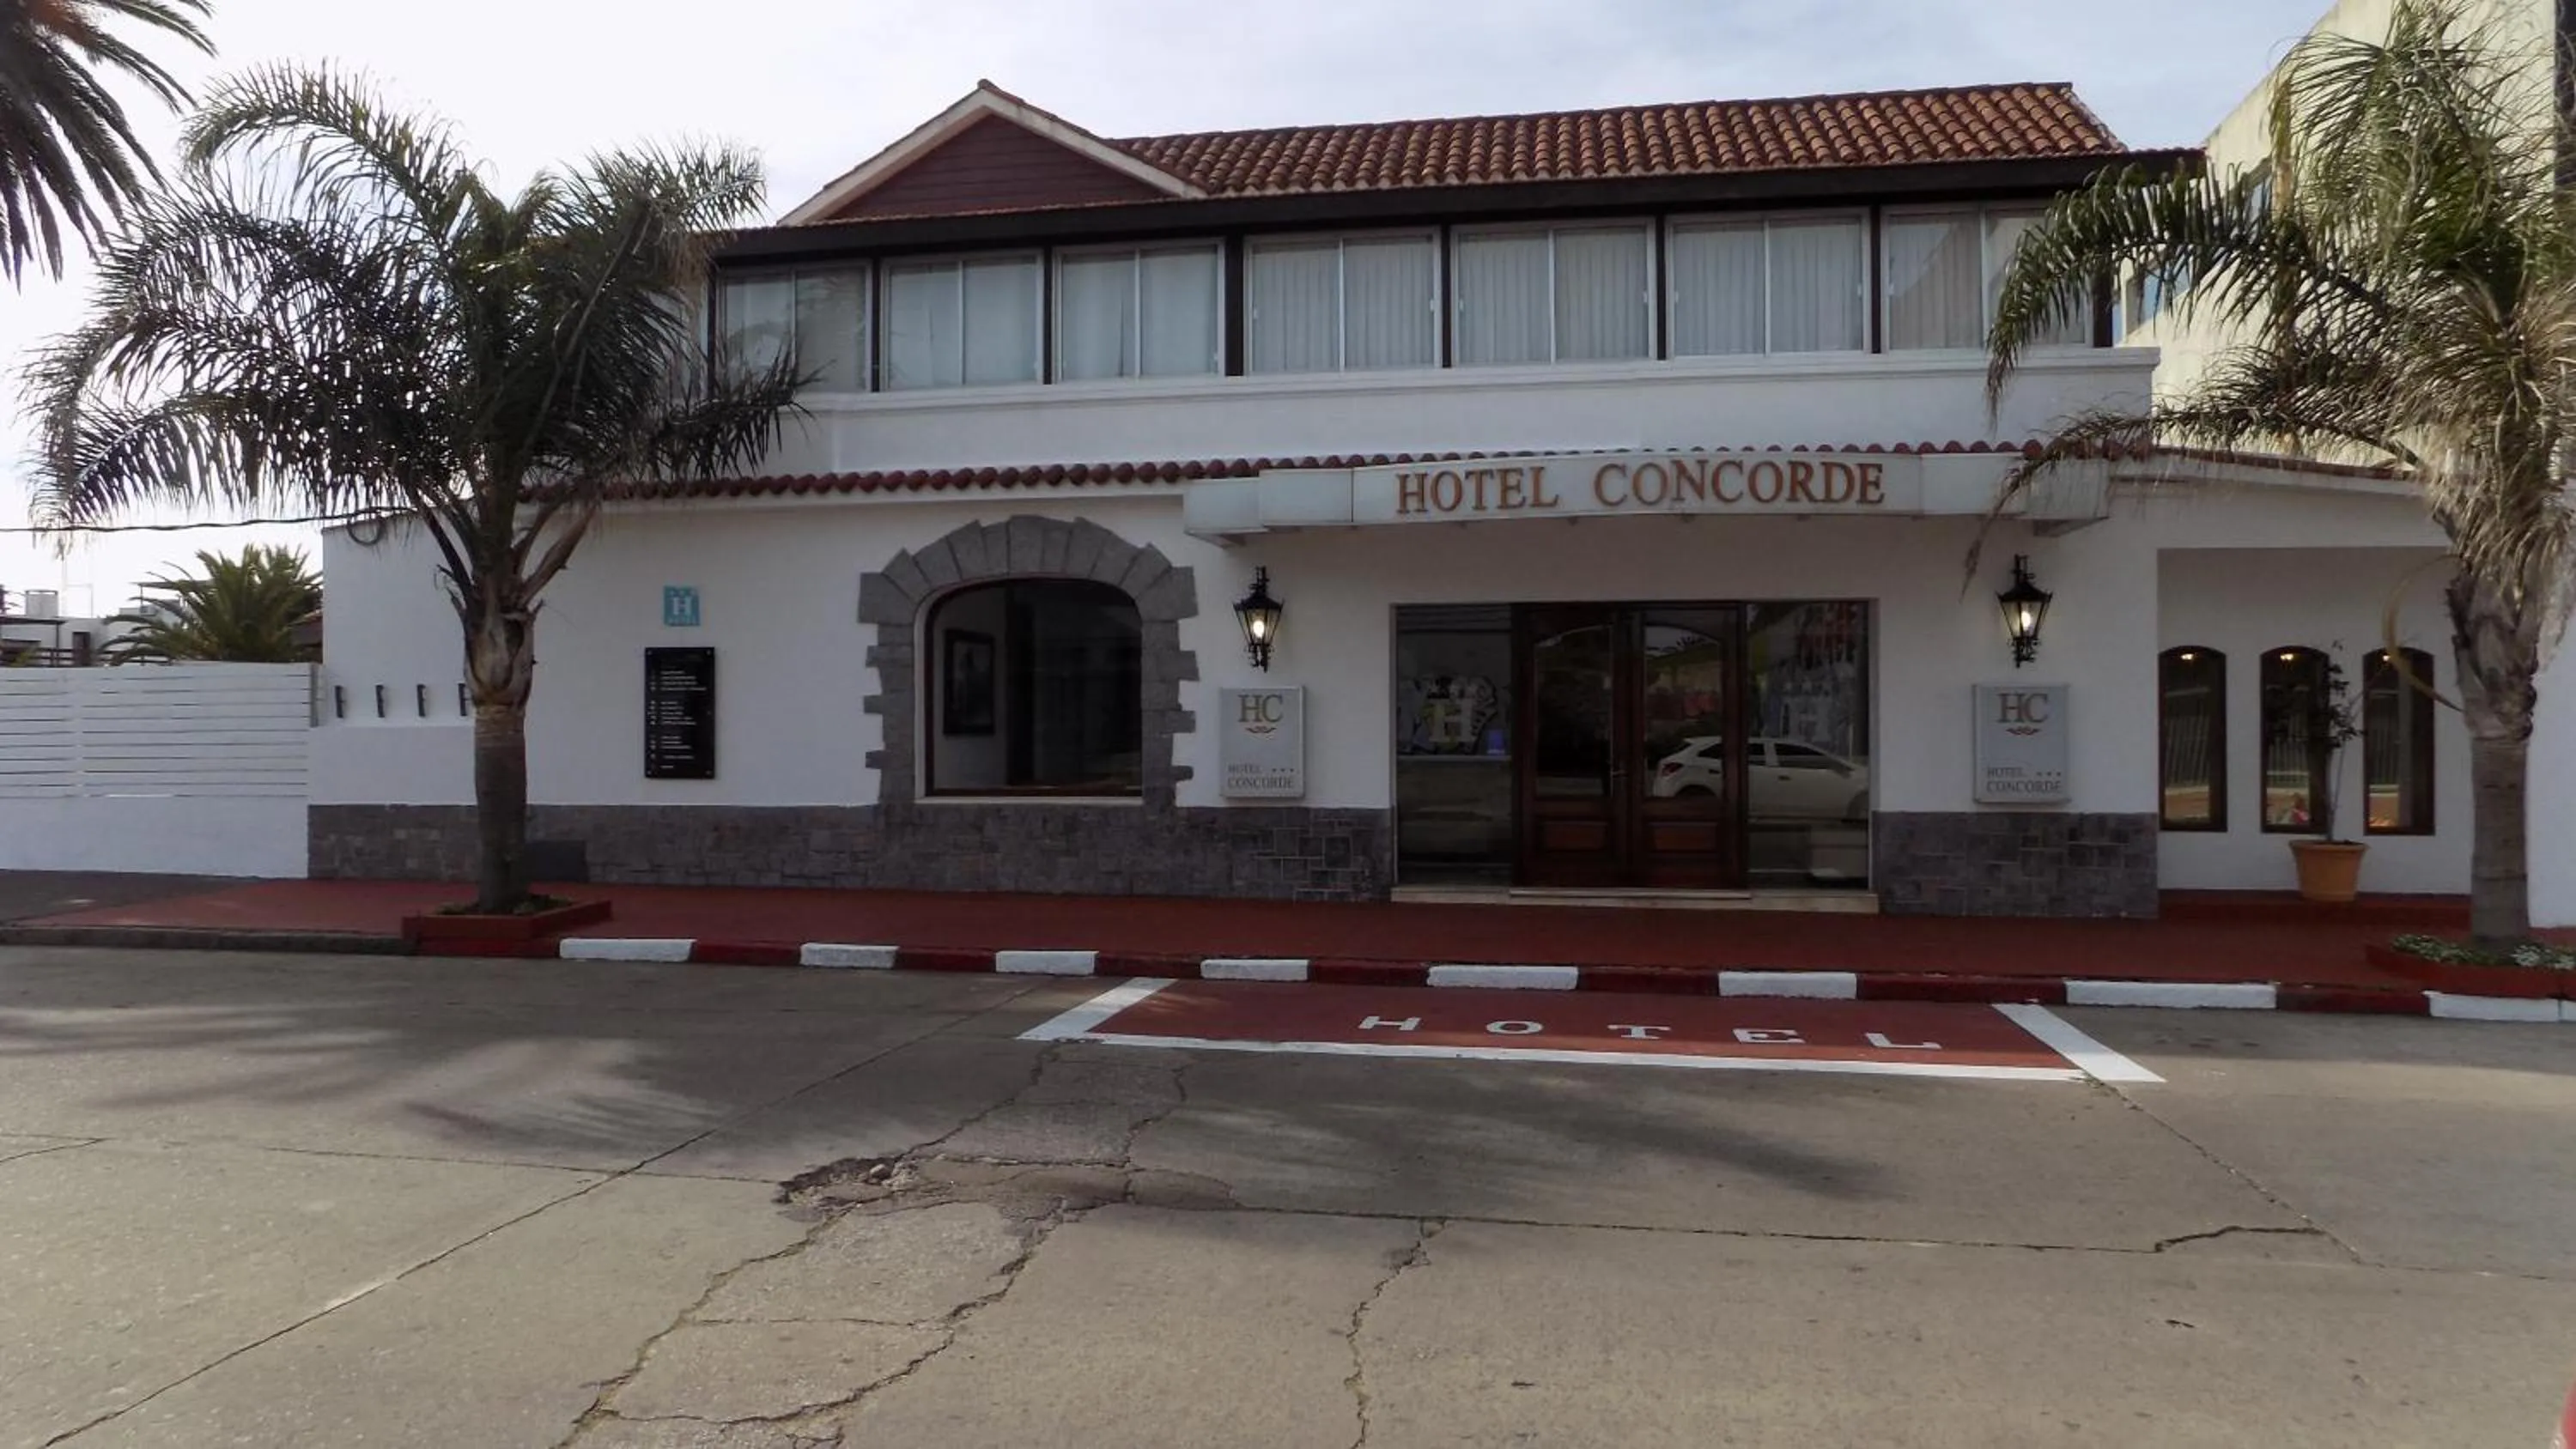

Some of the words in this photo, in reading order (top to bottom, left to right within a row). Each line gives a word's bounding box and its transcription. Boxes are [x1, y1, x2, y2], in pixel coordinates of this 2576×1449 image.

[1395, 466, 1559, 513] HOTEL
[1593, 459, 1886, 507] CONCORDE
[671, 596, 693, 615] H
[1237, 694, 1284, 723] HC
[1996, 693, 2049, 723] HC
[1228, 763, 1262, 773] HOTEL
[1987, 767, 2027, 778] HOTEL
[1228, 776, 1295, 789] CONCORDE
[1987, 779, 2063, 793] CONCORDE
[1358, 1016, 1943, 1050] HOTEL
